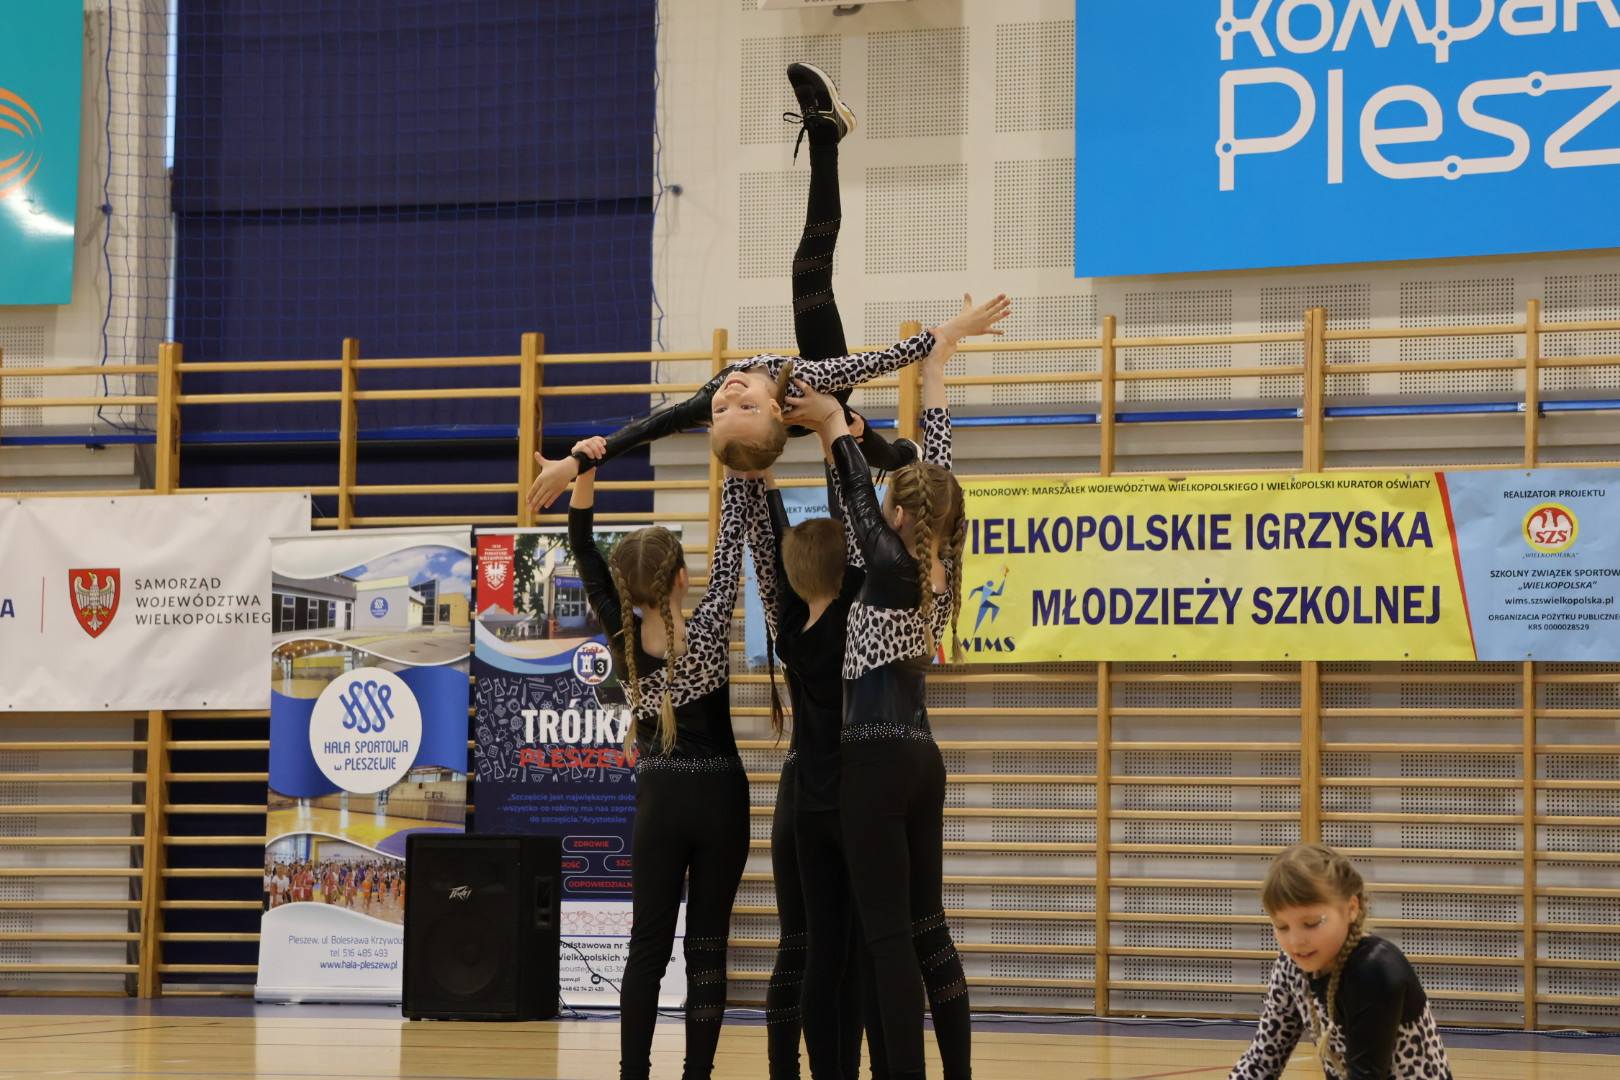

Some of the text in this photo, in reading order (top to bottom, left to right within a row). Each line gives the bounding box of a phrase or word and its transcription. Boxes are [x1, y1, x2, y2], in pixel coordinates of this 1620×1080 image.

[1032, 486, 1086, 496] MARSZAŁEK
[1088, 482, 1166, 493] WOJEWÓDZTWA
[1168, 481, 1259, 492] WIELKOPOLSKIEGO
[1260, 482, 1264, 491] I
[1266, 480, 1335, 491] WIELKOPOLSKI
[1337, 480, 1383, 489] KURATOR
[1385, 478, 1431, 489] OŚWIATY
[1503, 489, 1606, 499] REALIZATOR PROJEKTU
[963, 511, 1434, 556] IELKOPOLSKIE IGRZYSKA
[1534, 530, 1568, 544] SZS
[1490, 569, 1529, 578] SZKOLNY
[1531, 569, 1572, 579] ZWIĄZEK
[135, 577, 222, 591] SAMORZĄD
[136, 594, 262, 608] WOJEWÓDZTWA
[1032, 577, 1440, 627] MŁODZIEŻY SZKOLNEJ
[1504, 596, 1614, 606] wims.szswielkopolska.pl
[135, 612, 272, 625] WIELKOPOLSKIEG
[1541, 612, 1576, 621] POŻYTKU
[596, 661, 605, 674] 3
[324, 739, 409, 754] HALA SPORTOWA
[344, 756, 397, 771] PLESZEWIE
